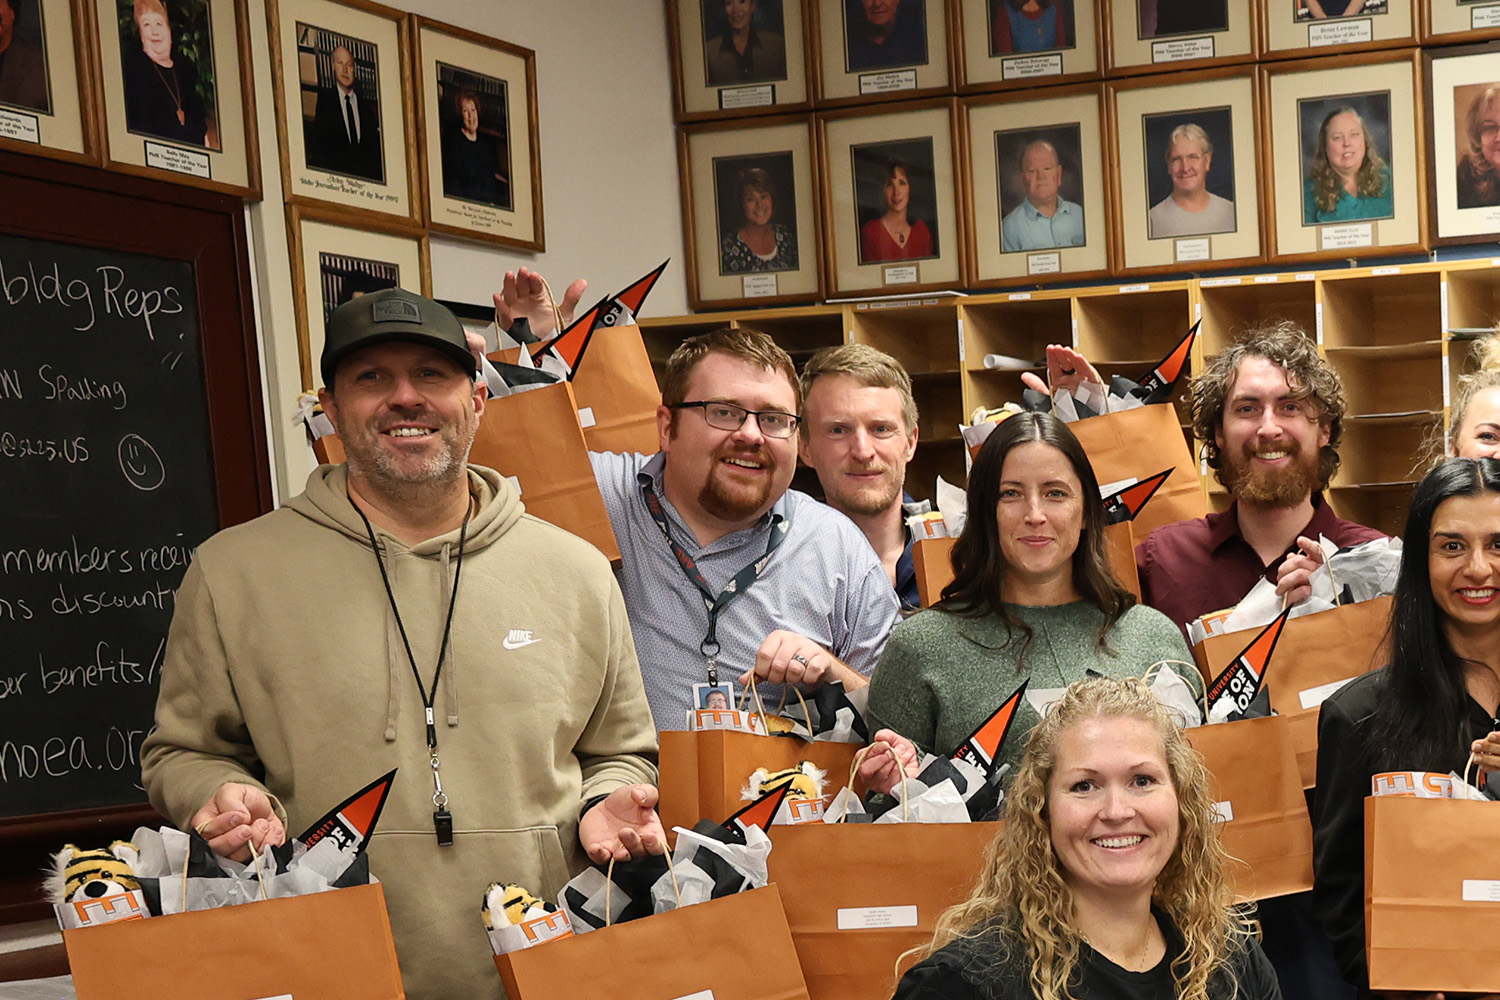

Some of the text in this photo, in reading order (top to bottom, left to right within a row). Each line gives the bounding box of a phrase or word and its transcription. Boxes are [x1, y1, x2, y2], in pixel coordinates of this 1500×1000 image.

[97, 266, 183, 341] Reps
[3, 535, 133, 574] members
[508, 629, 533, 643] NIKE
[1208, 663, 1240, 700] UNIVERSITY
[1230, 668, 1247, 693] OF
